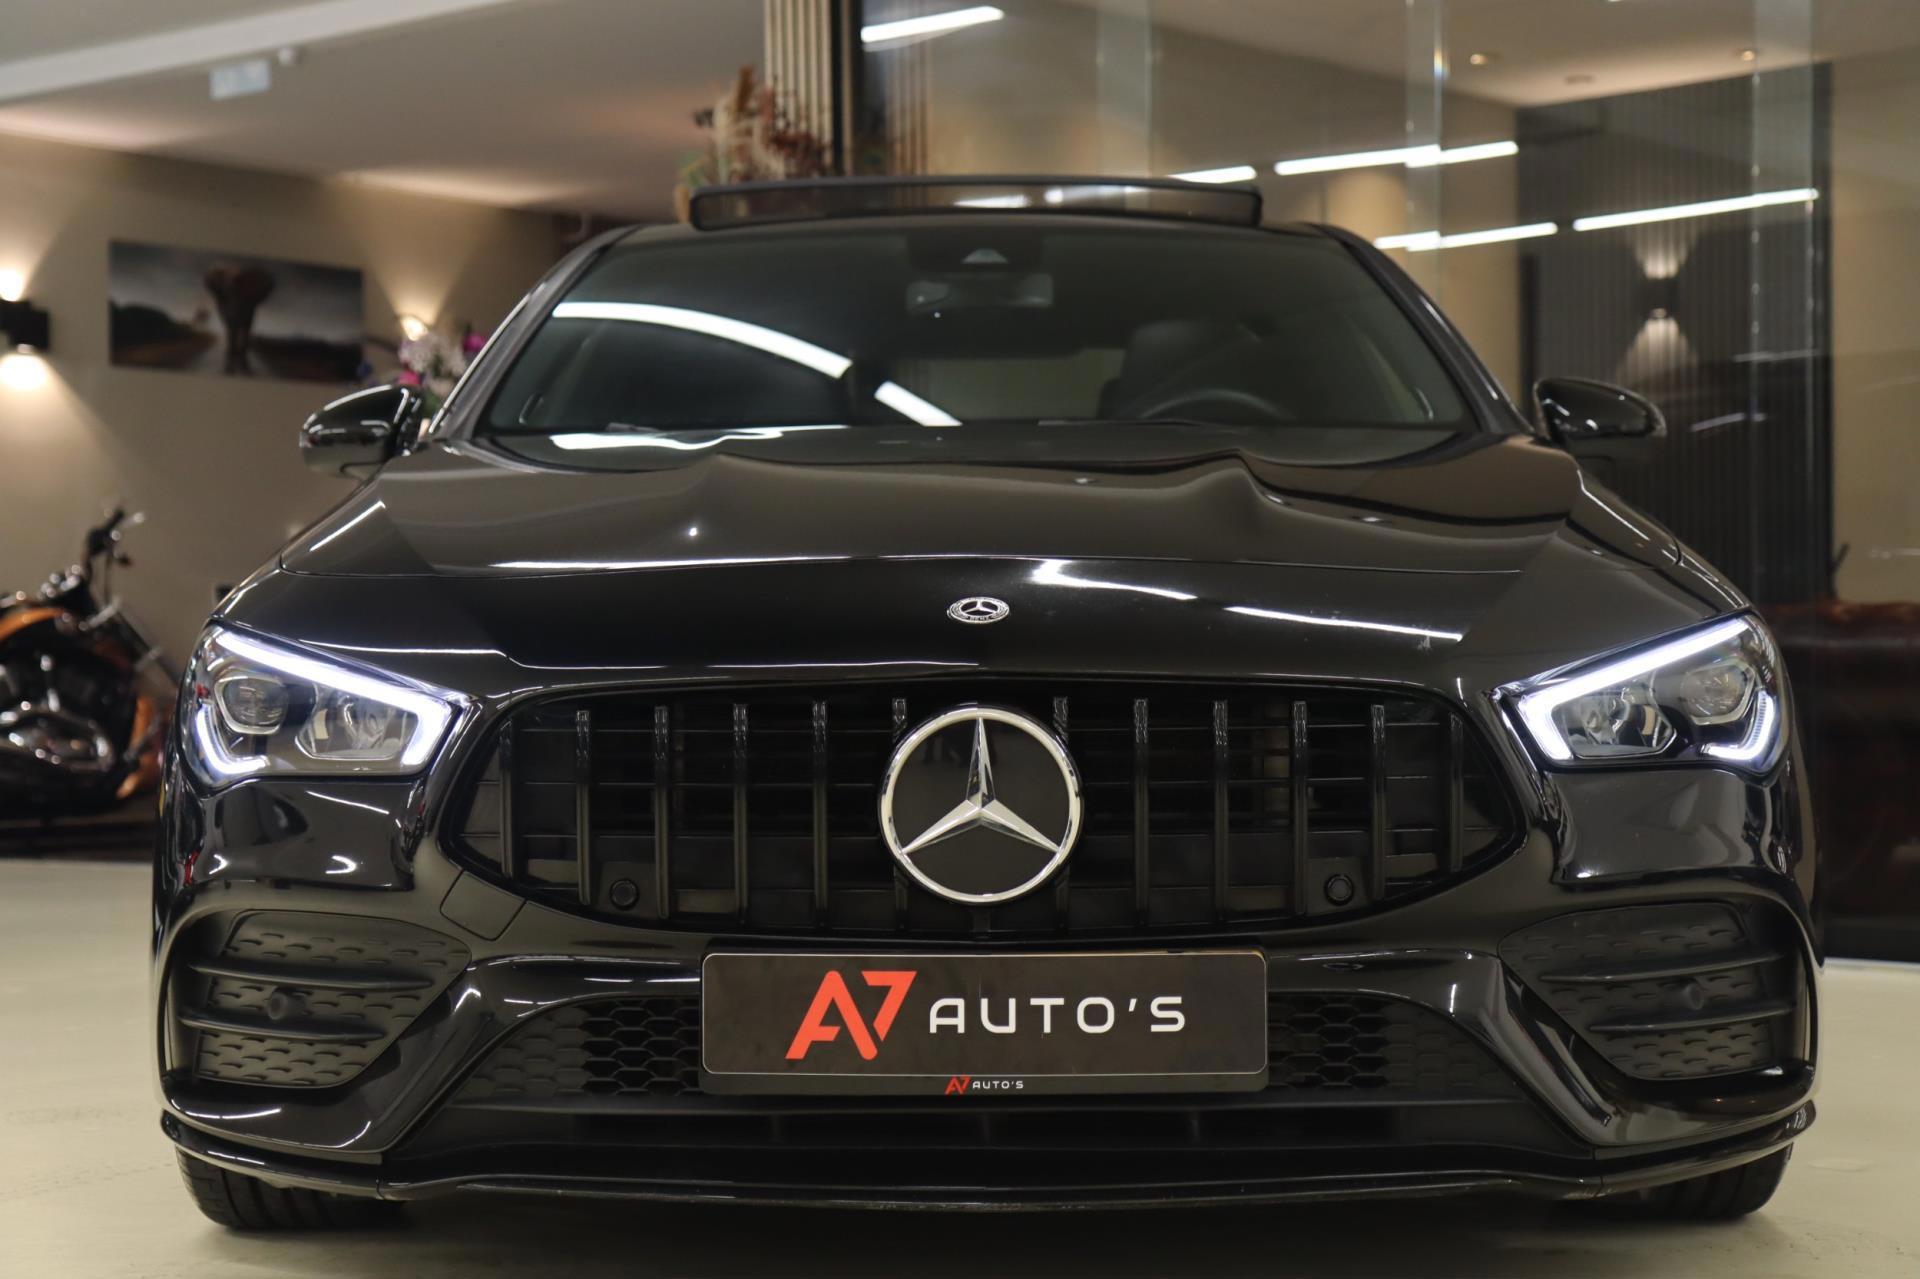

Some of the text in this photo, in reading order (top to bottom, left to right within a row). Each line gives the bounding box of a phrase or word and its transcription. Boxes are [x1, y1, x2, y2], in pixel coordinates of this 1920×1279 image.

[785, 970, 1185, 1060] A7 AUTO'S
[944, 1075, 1024, 1095] A7 AUTO'S
